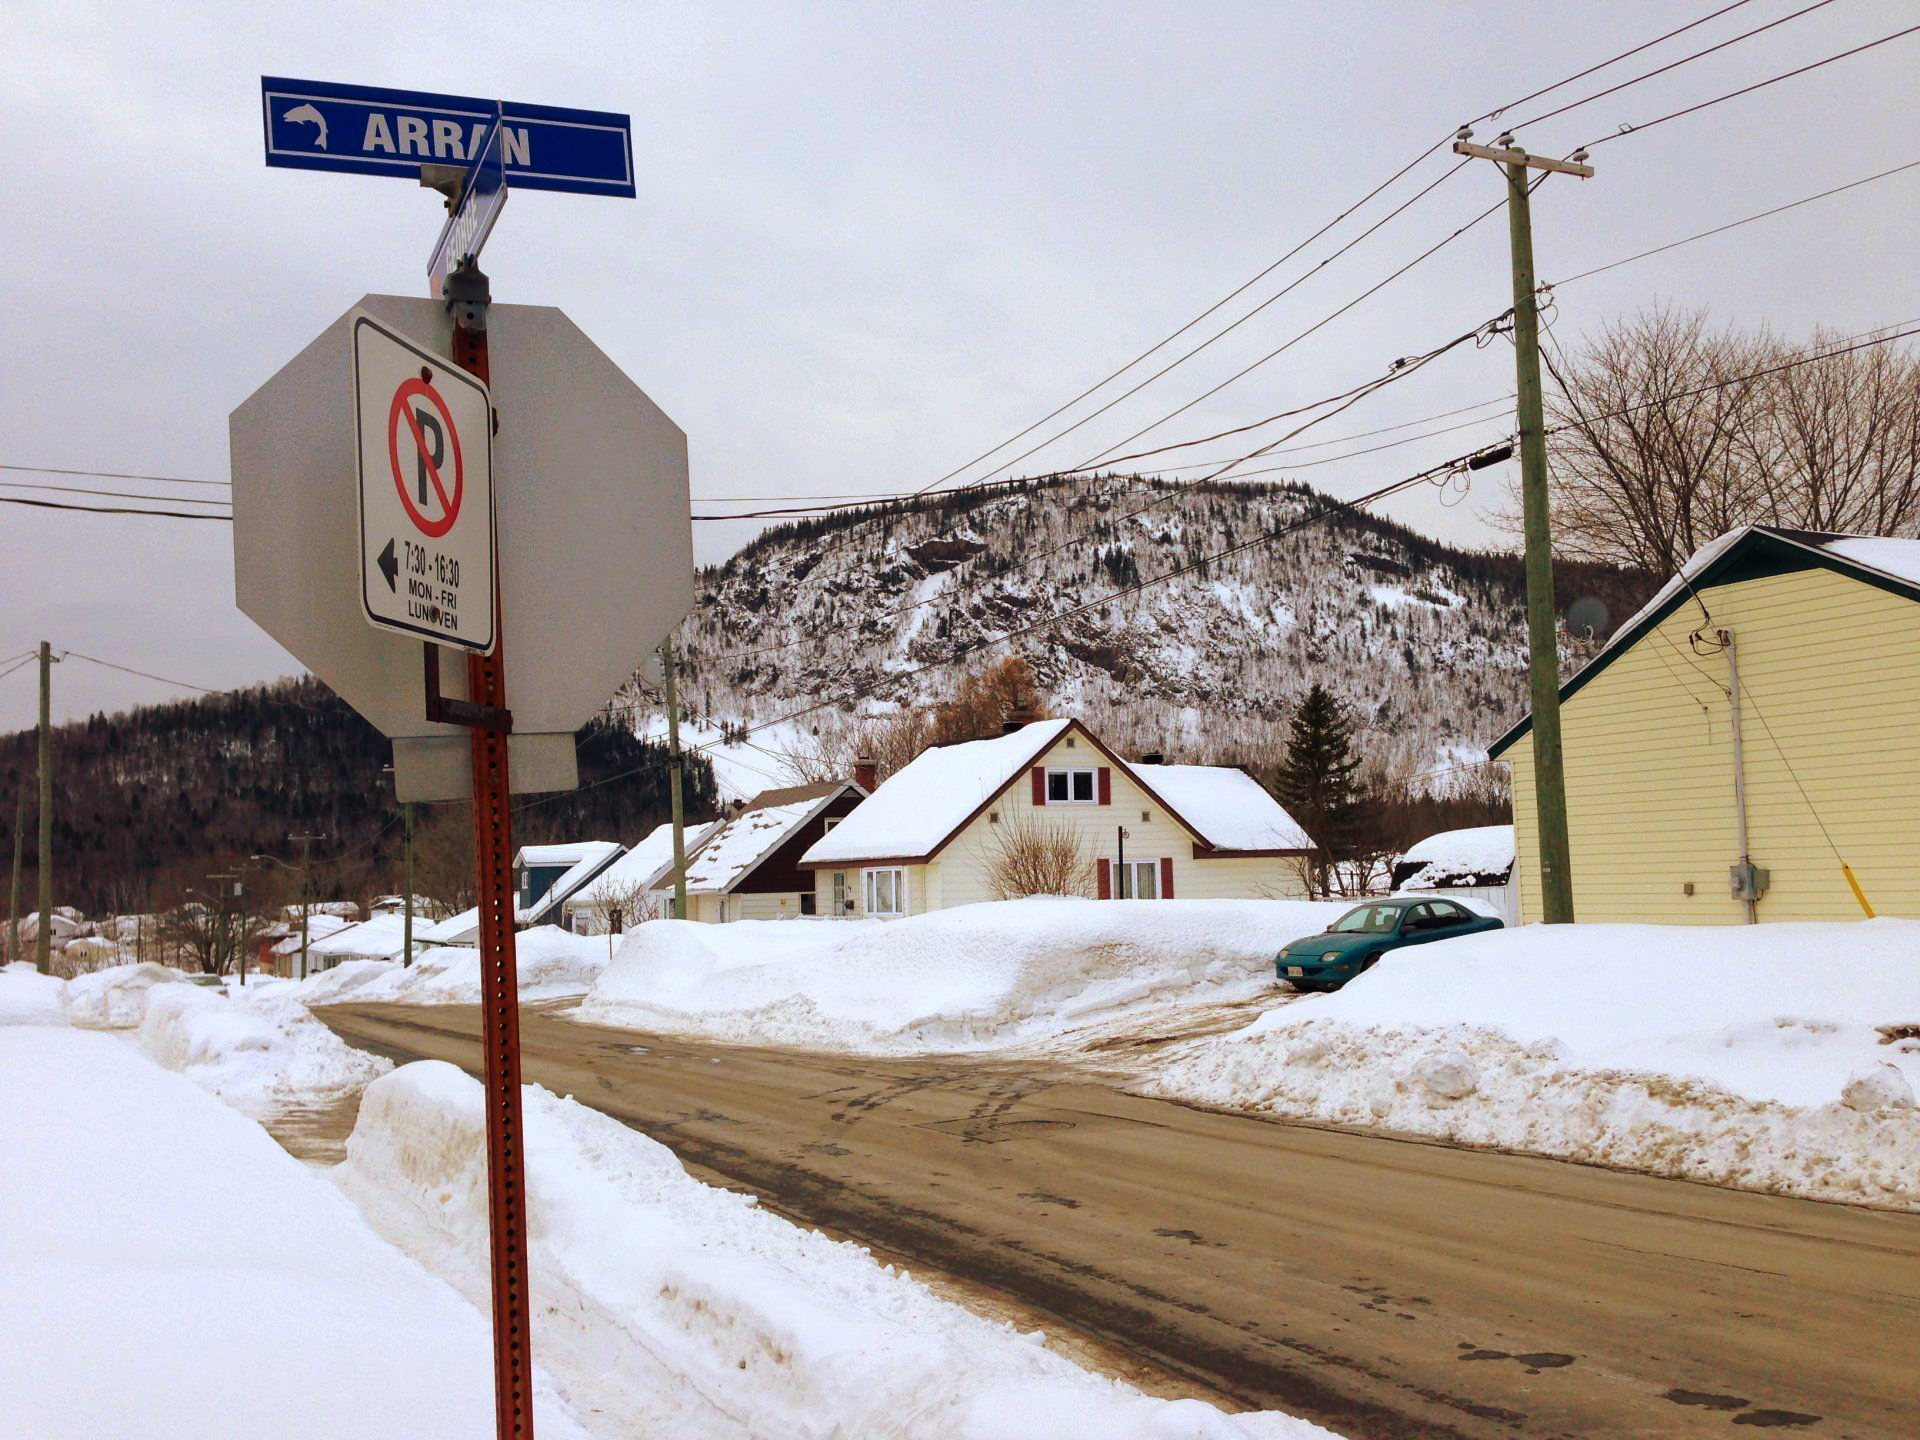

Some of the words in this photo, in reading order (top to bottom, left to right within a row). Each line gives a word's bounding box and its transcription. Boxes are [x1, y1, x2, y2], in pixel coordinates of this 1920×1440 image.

[405, 540, 426, 576] 7:30
[435, 553, 460, 588] 16:30
[409, 578, 432, 602] MON
[441, 589, 457, 610] FRI
[408, 600, 429, 622] LUN
[439, 610, 458, 631] VEN
